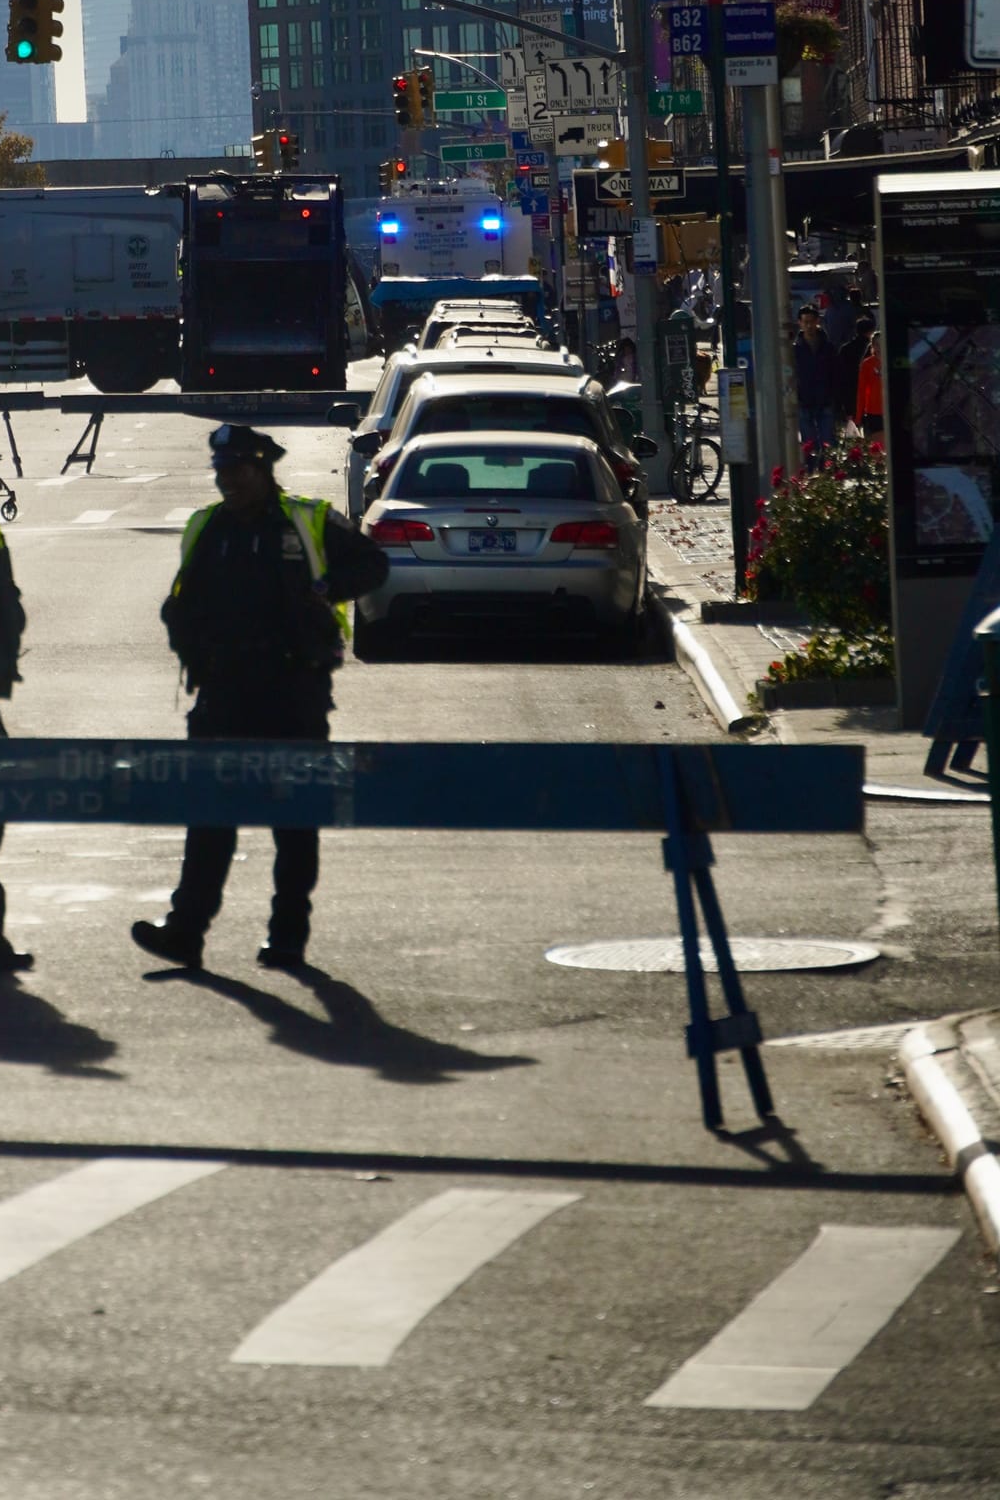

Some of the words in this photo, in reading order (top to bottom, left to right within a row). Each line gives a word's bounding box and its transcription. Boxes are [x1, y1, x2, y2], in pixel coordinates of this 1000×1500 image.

[673, 8, 702, 28] B32
[673, 33, 702, 53] B62
[477, 94, 488, 106] St
[550, 99, 569, 109] ONLY
[574, 98, 592, 108] ONLY
[597, 97, 616, 107] ONLY
[658, 95, 674, 111] 47
[679, 94, 691, 105] Rd
[533, 102, 548, 120] 2
[587, 124, 612, 132] TRUCK
[475, 148, 484, 158] St
[518, 153, 543, 165] EAST
[648, 177, 673, 189] WAY
[58, 749, 105, 781] DO
[128, 750, 196, 781] NOT
[215, 750, 334, 786] CROSS
